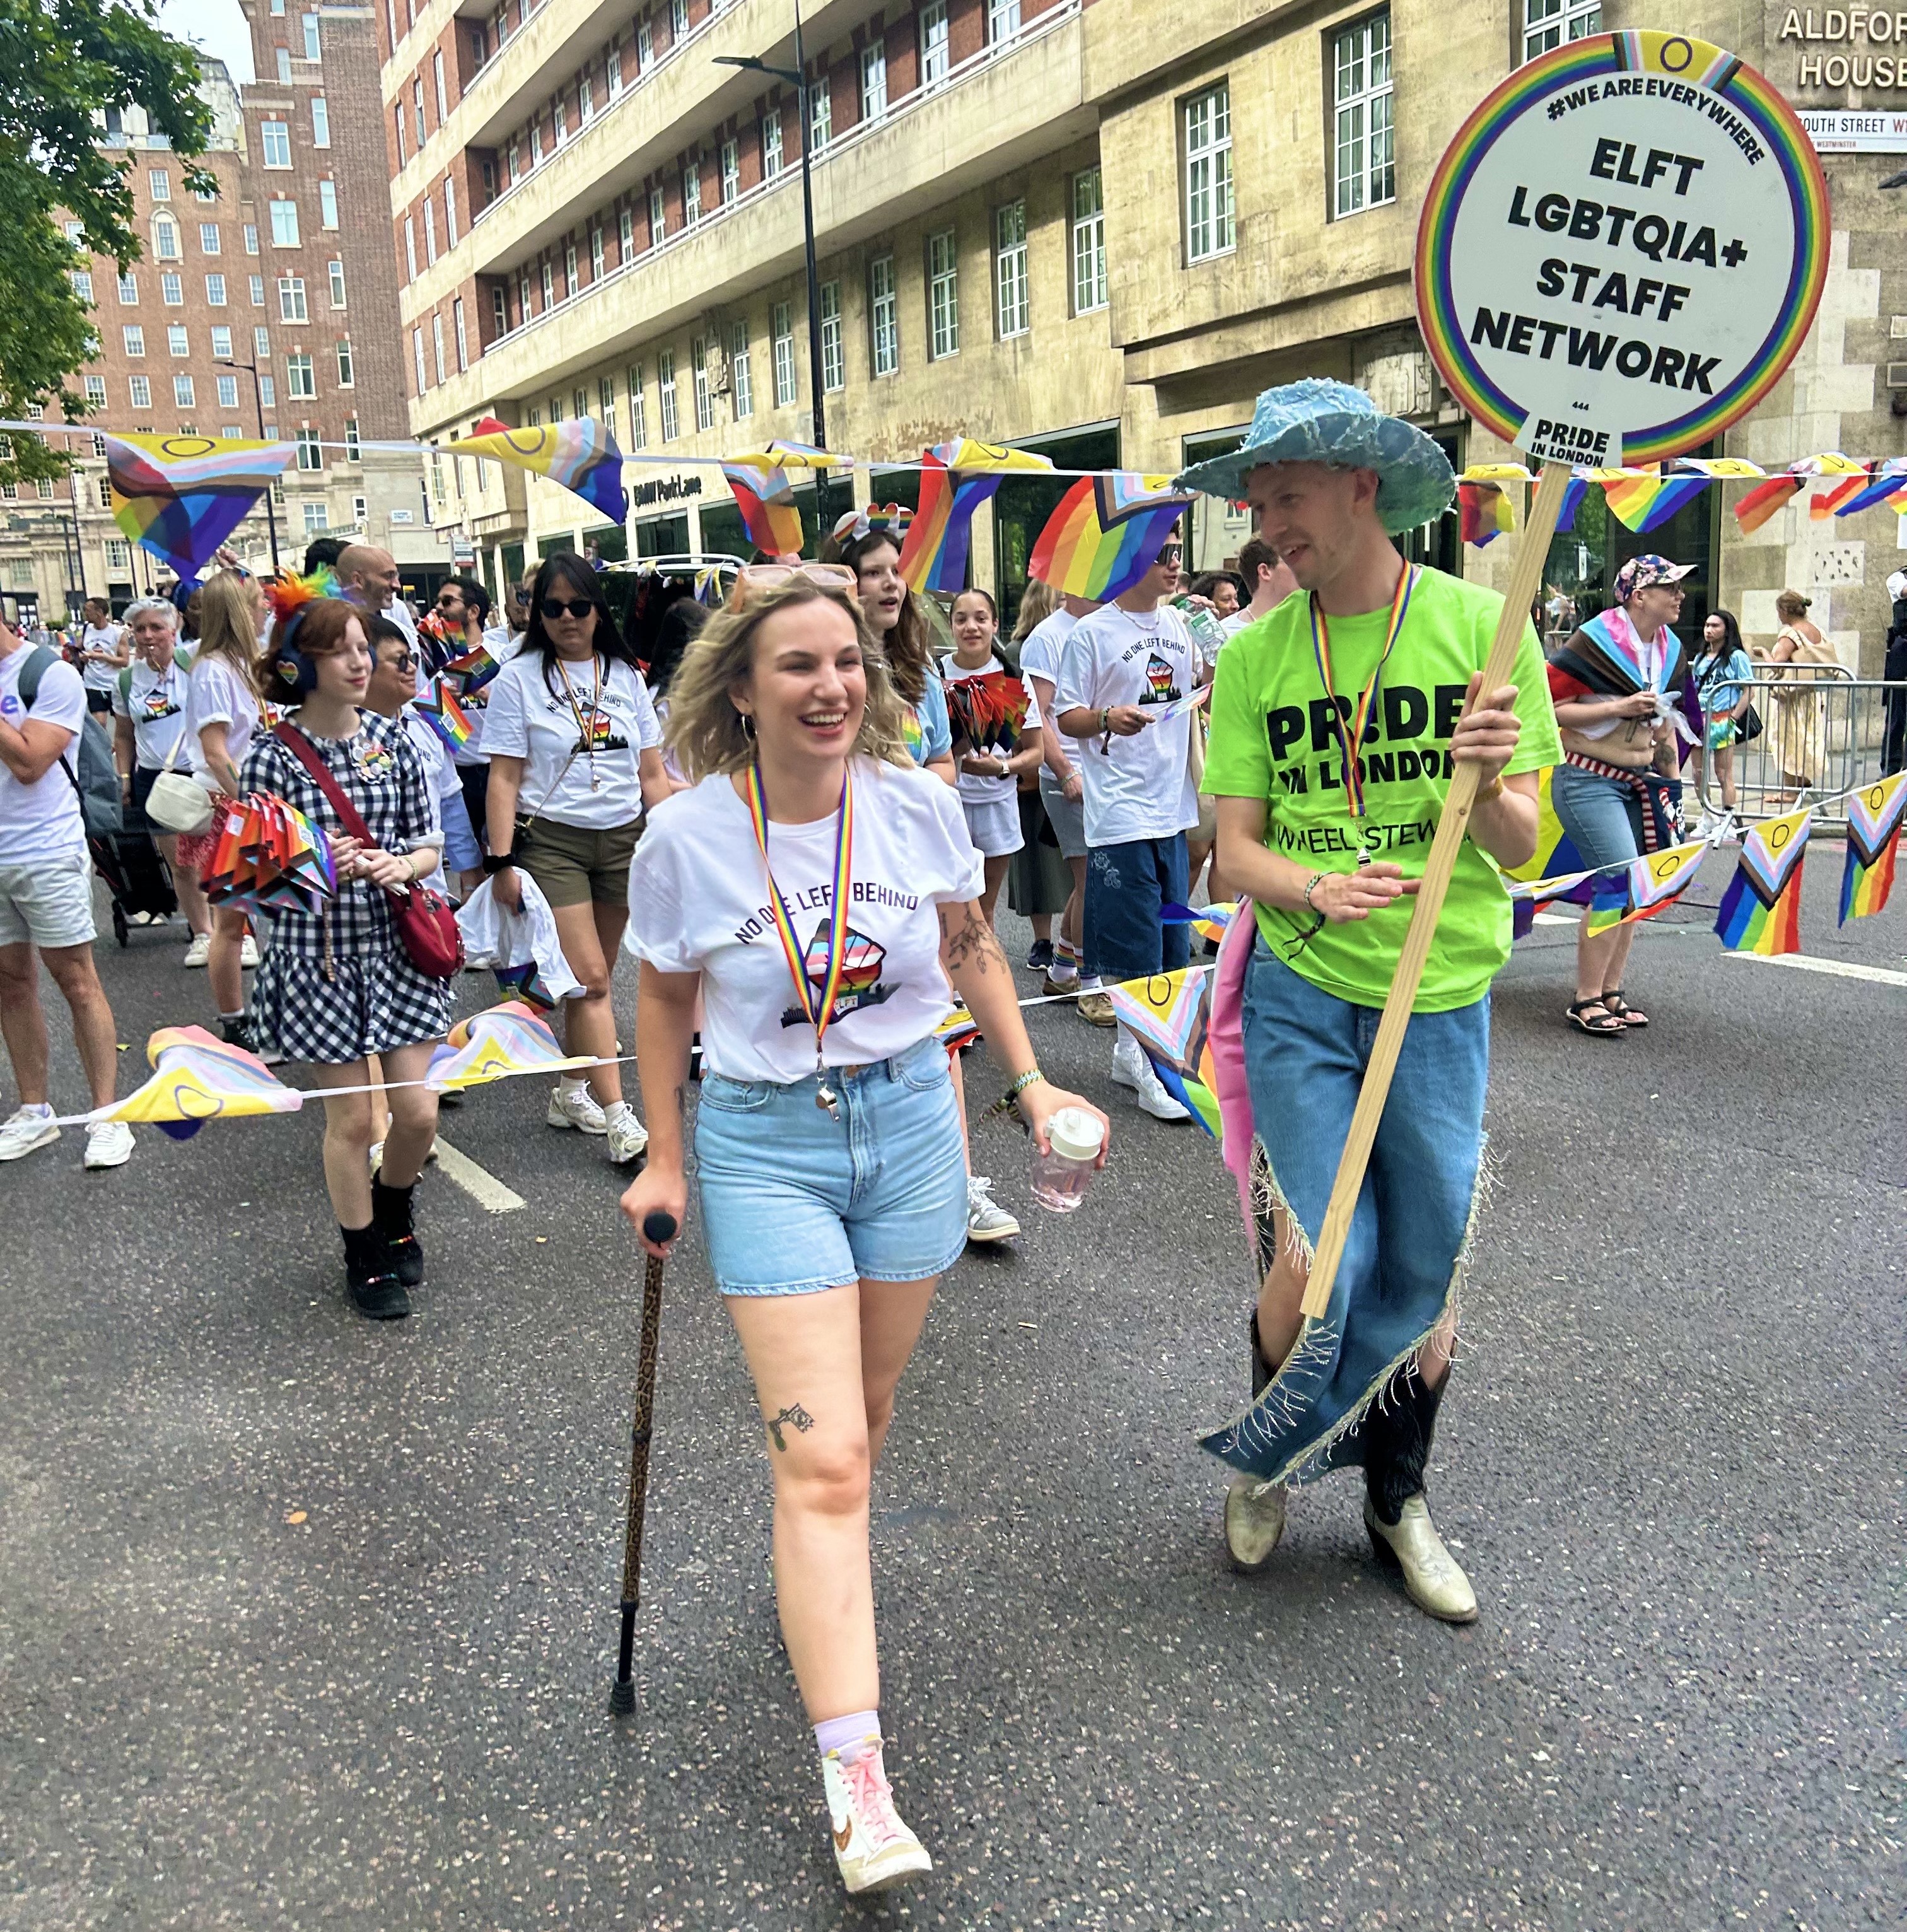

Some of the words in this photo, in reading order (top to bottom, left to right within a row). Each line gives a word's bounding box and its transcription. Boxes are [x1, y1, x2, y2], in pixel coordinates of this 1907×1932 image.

[1800, 55, 1907, 87] HOUSE
[1800, 117, 1835, 132] OUTH
[1841, 118, 1886, 133] STREET
[1892, 118, 1907, 133] W
[1589, 137, 1705, 196] ELFT
[1508, 185, 1748, 269] LGBTQIA+
[1536, 258, 1691, 322] STAFF
[1470, 306, 1723, 395] NETWORK
[1572, 401, 1590, 411] 444
[1531, 442, 1547, 455] IN
[1548, 446, 1604, 468] LONDON
[1121, 650, 1133, 663] NO
[1130, 641, 1145, 655] ONE
[1143, 638, 1160, 648] LEFT
[1162, 638, 1186, 654] BEHIND
[546, 701, 559, 713] NO
[598, 691, 621, 708] EHIND
[1365, 819, 1439, 851] STEW
[735, 918, 763, 944] NO
[758, 896, 796, 925] OE
[796, 884, 832, 911] LEF
[853, 882, 918, 911] BEHIND
